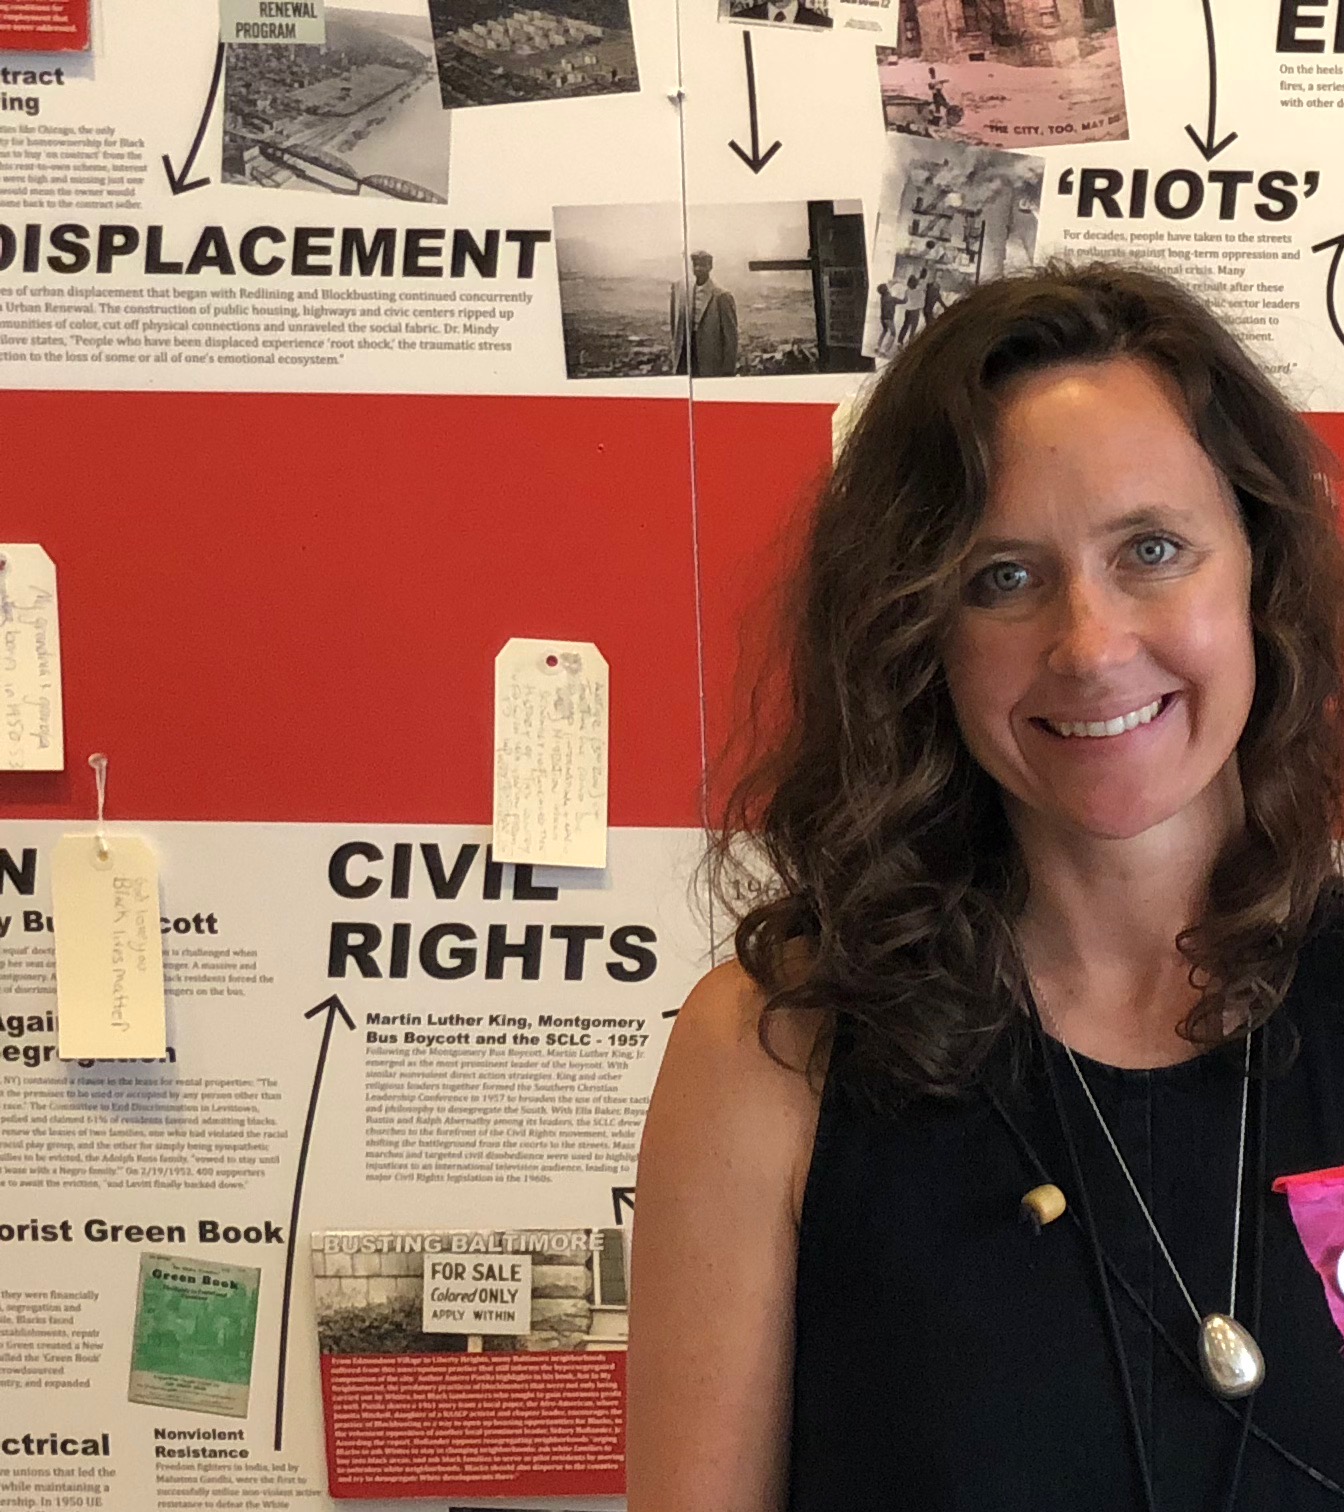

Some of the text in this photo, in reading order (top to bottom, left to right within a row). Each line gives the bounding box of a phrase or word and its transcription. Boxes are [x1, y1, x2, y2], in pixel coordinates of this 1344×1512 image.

[260, 2, 317, 18] RENEWAL
[236, 22, 296, 38] PROGRAM
[1279, 64, 1294, 75] On
[1297, 64, 1313, 75] the
[1316, 64, 1343, 75] heels
[328, 922, 657, 982] RIGHTS
[366, 1013, 645, 1032] Martin Luther King, Montgomery
[367, 1031, 649, 1048] Bus Boycott and the SCLC 1957
[85, 1218, 185, 1243] Green
[199, 1220, 284, 1243] Book
[323, 1232, 606, 1255] BUSTING BALTIMORE
[432, 1262, 521, 1282] FOR SALE
[430, 1286, 519, 1304] Colored ONLY
[432, 1309, 515, 1321] APPLY WITHIN
[154, 1427, 244, 1441] Nonviolent
[155, 1446, 249, 1459] Resistance
